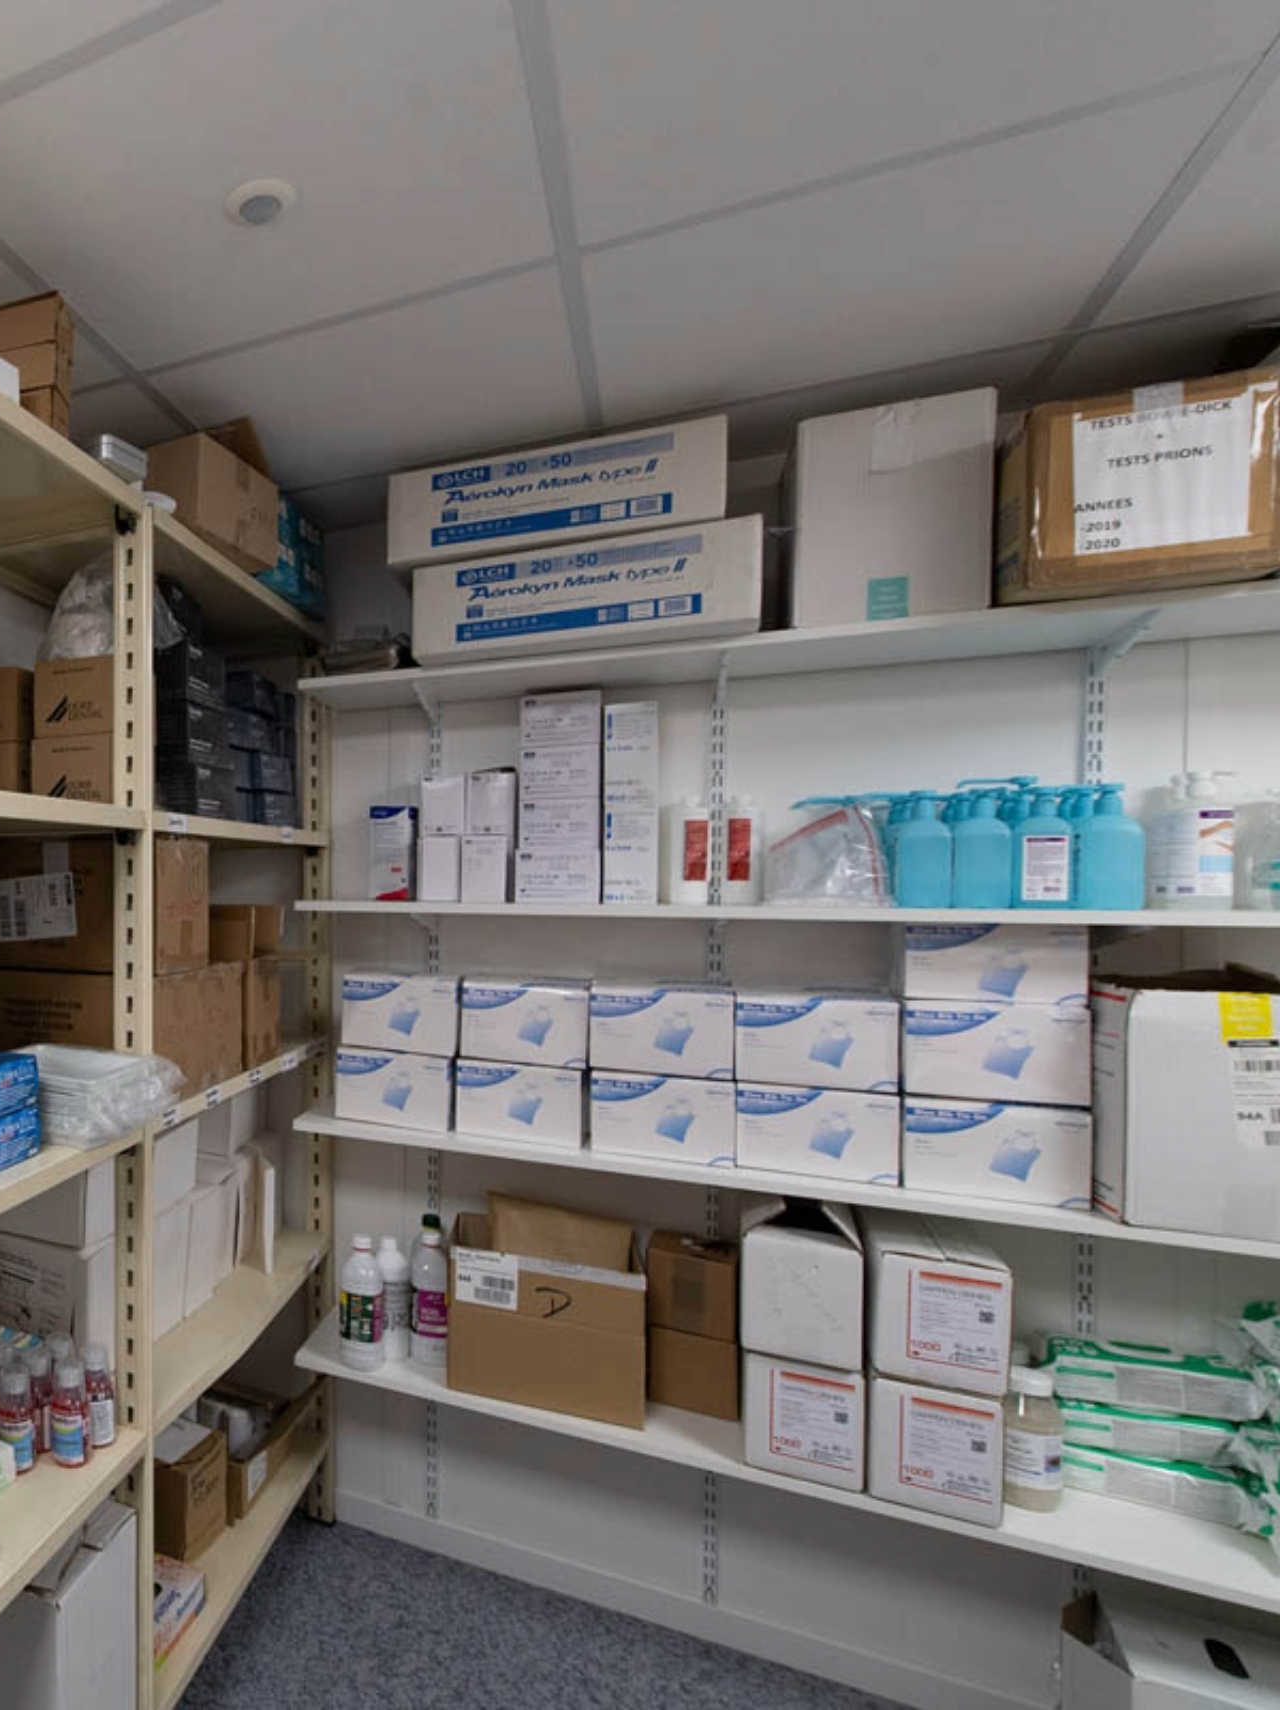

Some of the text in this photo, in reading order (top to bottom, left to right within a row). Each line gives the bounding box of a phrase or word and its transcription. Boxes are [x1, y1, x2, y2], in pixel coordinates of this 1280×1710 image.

[1091, 415, 1133, 431] TESTS
[1107, 445, 1214, 469] TESTS PRIONS
[505, 460, 527, 477] 20
[536, 471, 594, 491] Mask
[598, 466, 642, 482] type
[529, 561, 552, 575] 20
[563, 570, 621, 589] Mask
[625, 564, 670, 582] type
